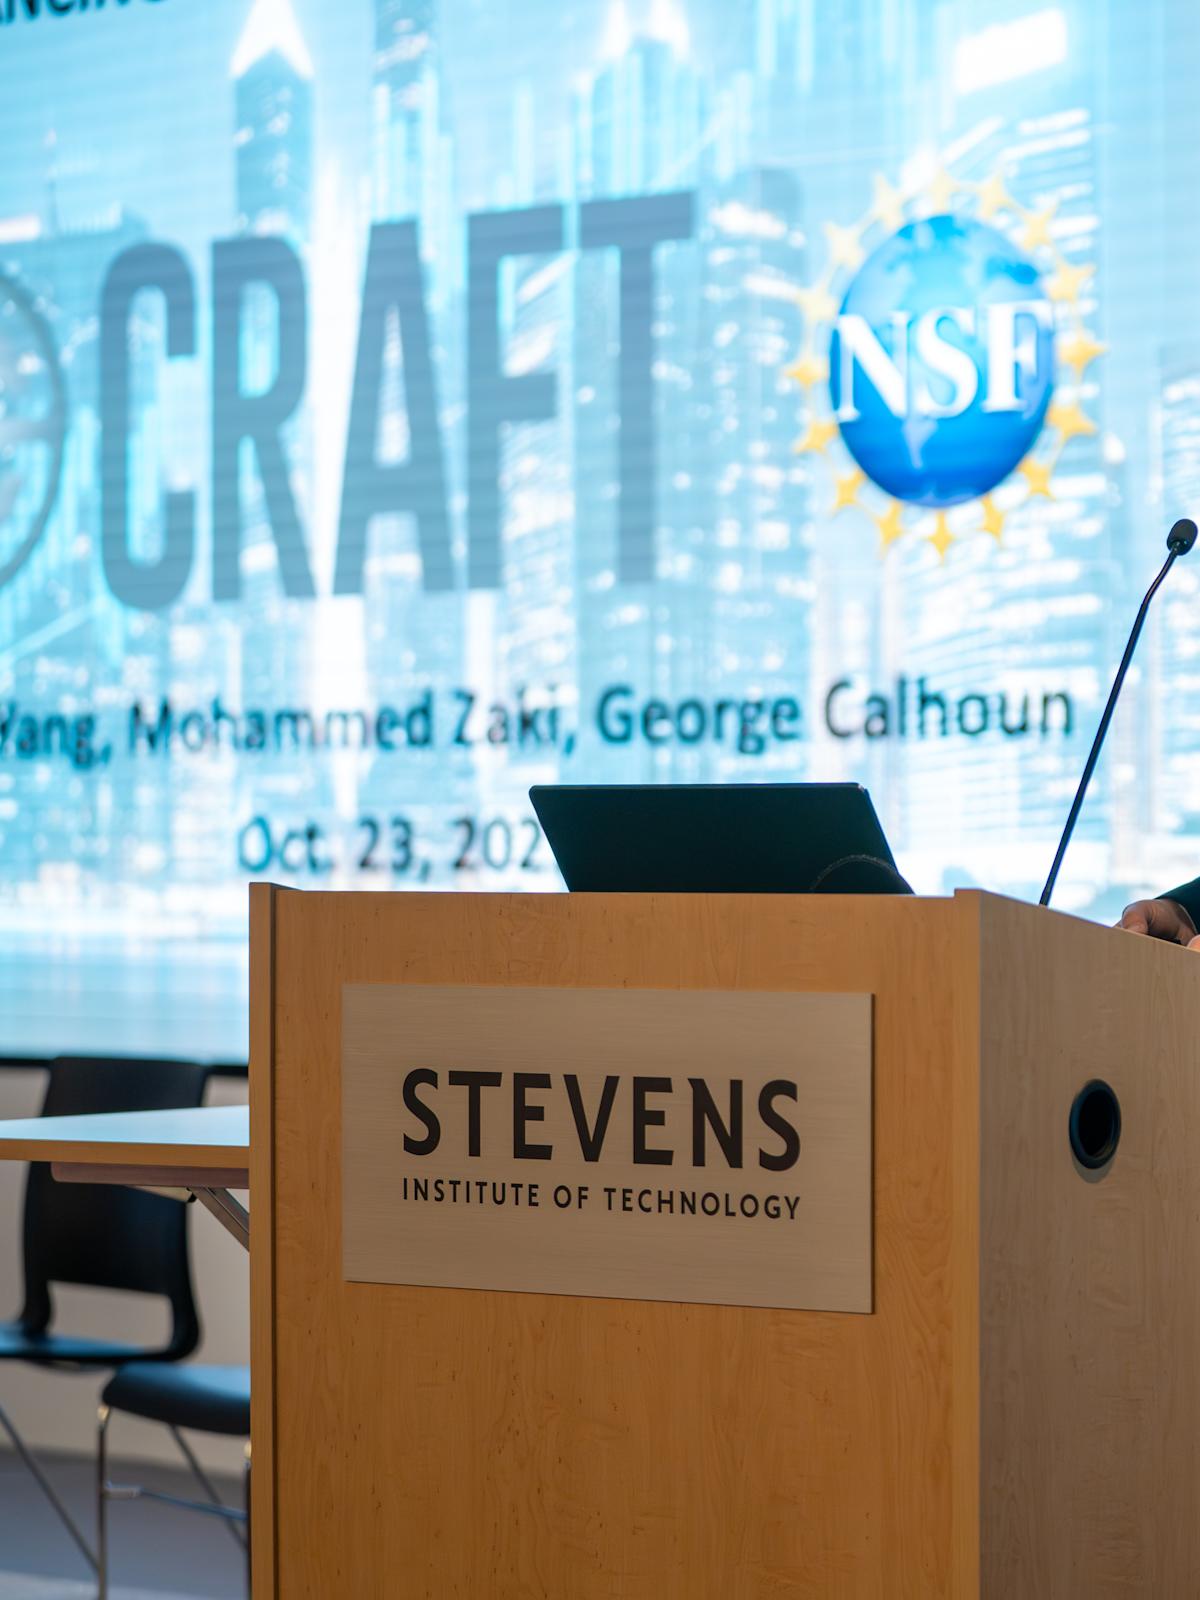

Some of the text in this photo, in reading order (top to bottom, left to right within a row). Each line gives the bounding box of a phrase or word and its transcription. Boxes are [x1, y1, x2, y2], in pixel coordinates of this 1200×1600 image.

[101, 190, 695, 609] CRAFT
[834, 299, 1054, 423] NSF
[129, 690, 433, 755] Mohammed
[453, 685, 576, 755] Zaki,
[597, 685, 802, 755] George
[823, 676, 1074, 737] Calhoun
[358, 816, 430, 882] 23,
[452, 817, 542, 869] 202
[402, 1068, 800, 1172] STEVENS
[402, 1178, 801, 1220] INSTITUTE OF TECHNOLOGY
